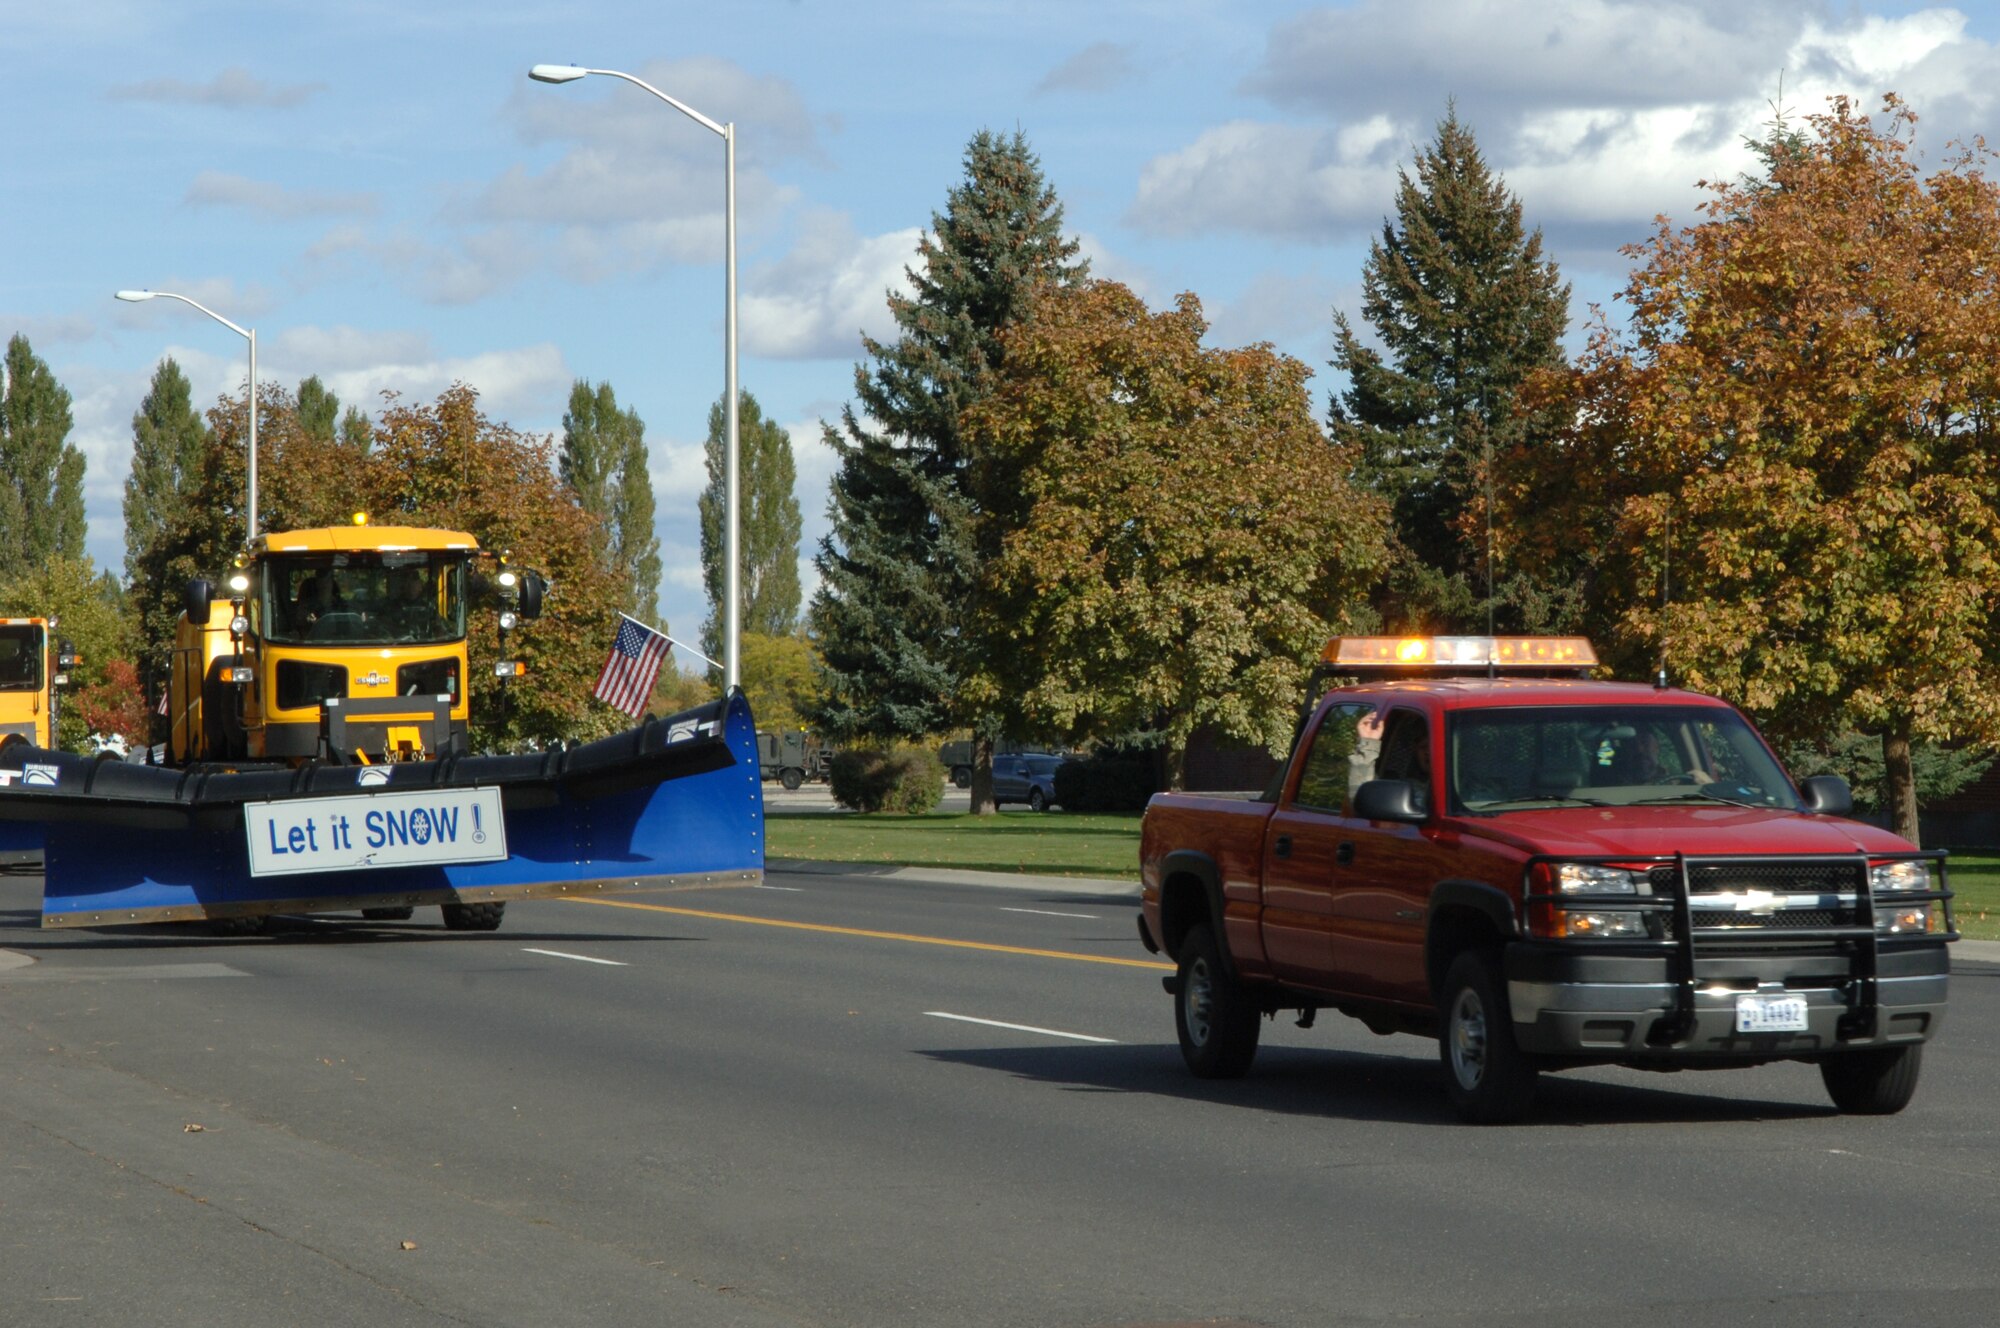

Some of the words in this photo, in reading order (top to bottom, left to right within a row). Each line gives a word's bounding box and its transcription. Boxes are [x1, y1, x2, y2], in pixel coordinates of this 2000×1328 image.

[268, 818, 318, 854] Let
[329, 814, 352, 850] it
[365, 806, 459, 849] SNOW
